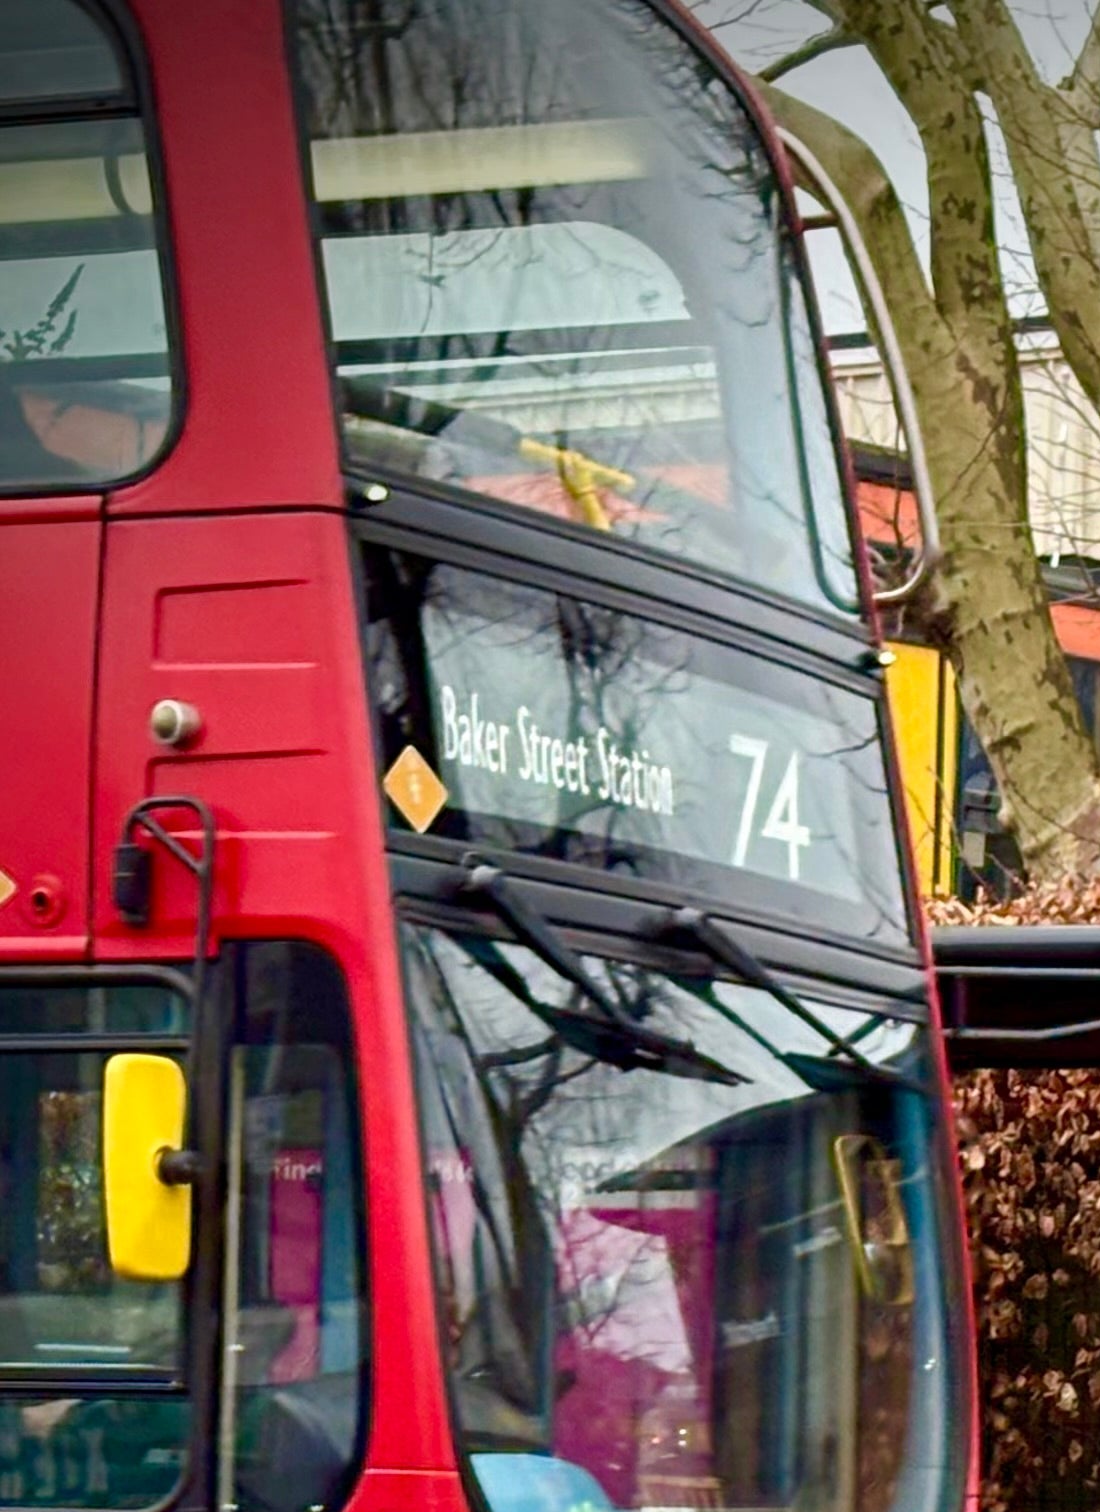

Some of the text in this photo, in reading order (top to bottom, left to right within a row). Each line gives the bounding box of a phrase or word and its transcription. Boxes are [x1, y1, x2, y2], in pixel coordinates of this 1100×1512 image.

[441, 684, 674, 816] Baker Street Station
[729, 733, 811, 880] 74
